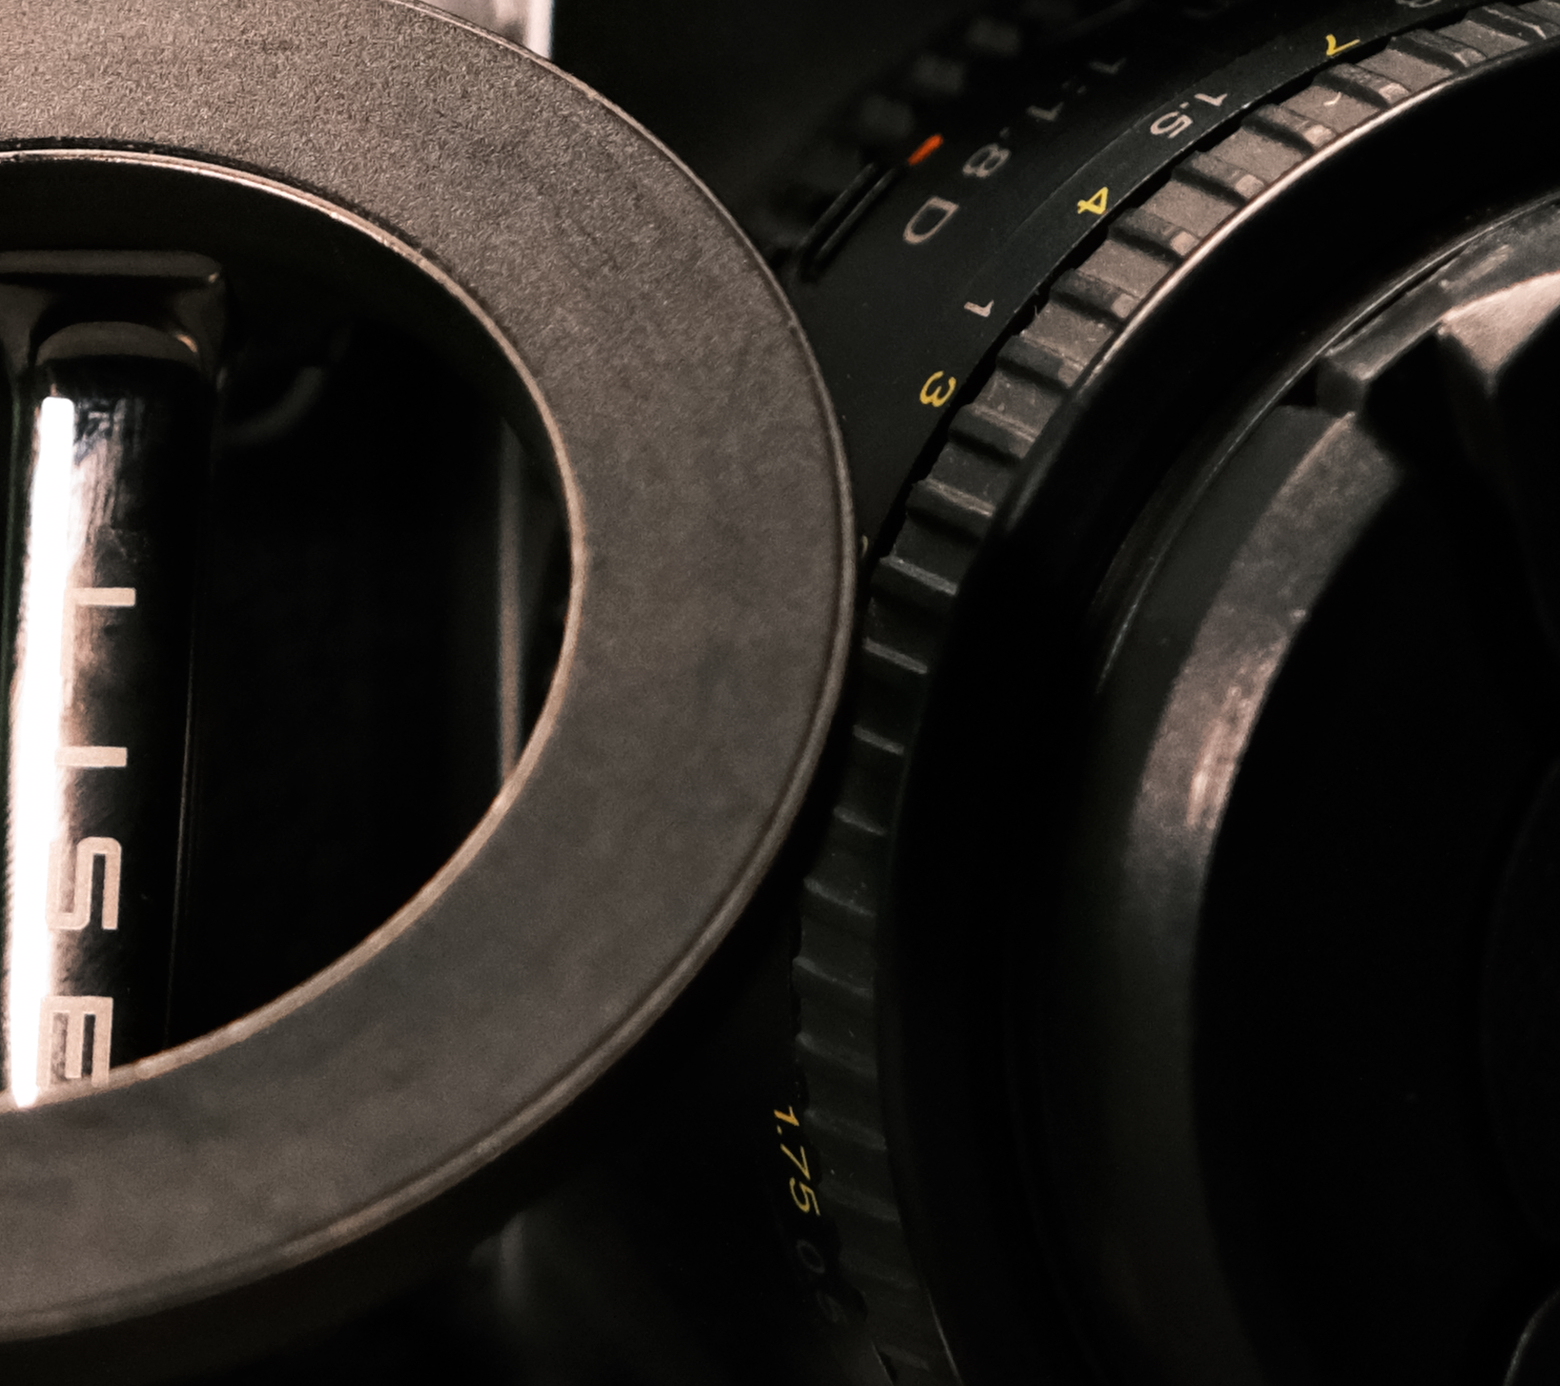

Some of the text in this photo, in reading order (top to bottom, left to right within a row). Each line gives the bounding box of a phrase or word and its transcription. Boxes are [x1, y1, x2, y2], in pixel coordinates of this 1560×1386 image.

[1324, 32, 1362, 57] 7
[1148, 91, 1230, 139] 1.5
[1075, 185, 1111, 215] 4
[901, 194, 961, 246] D
[962, 298, 996, 318] 1
[918, 369, 959, 408] 3
[773, 1104, 822, 1217] 1.75
